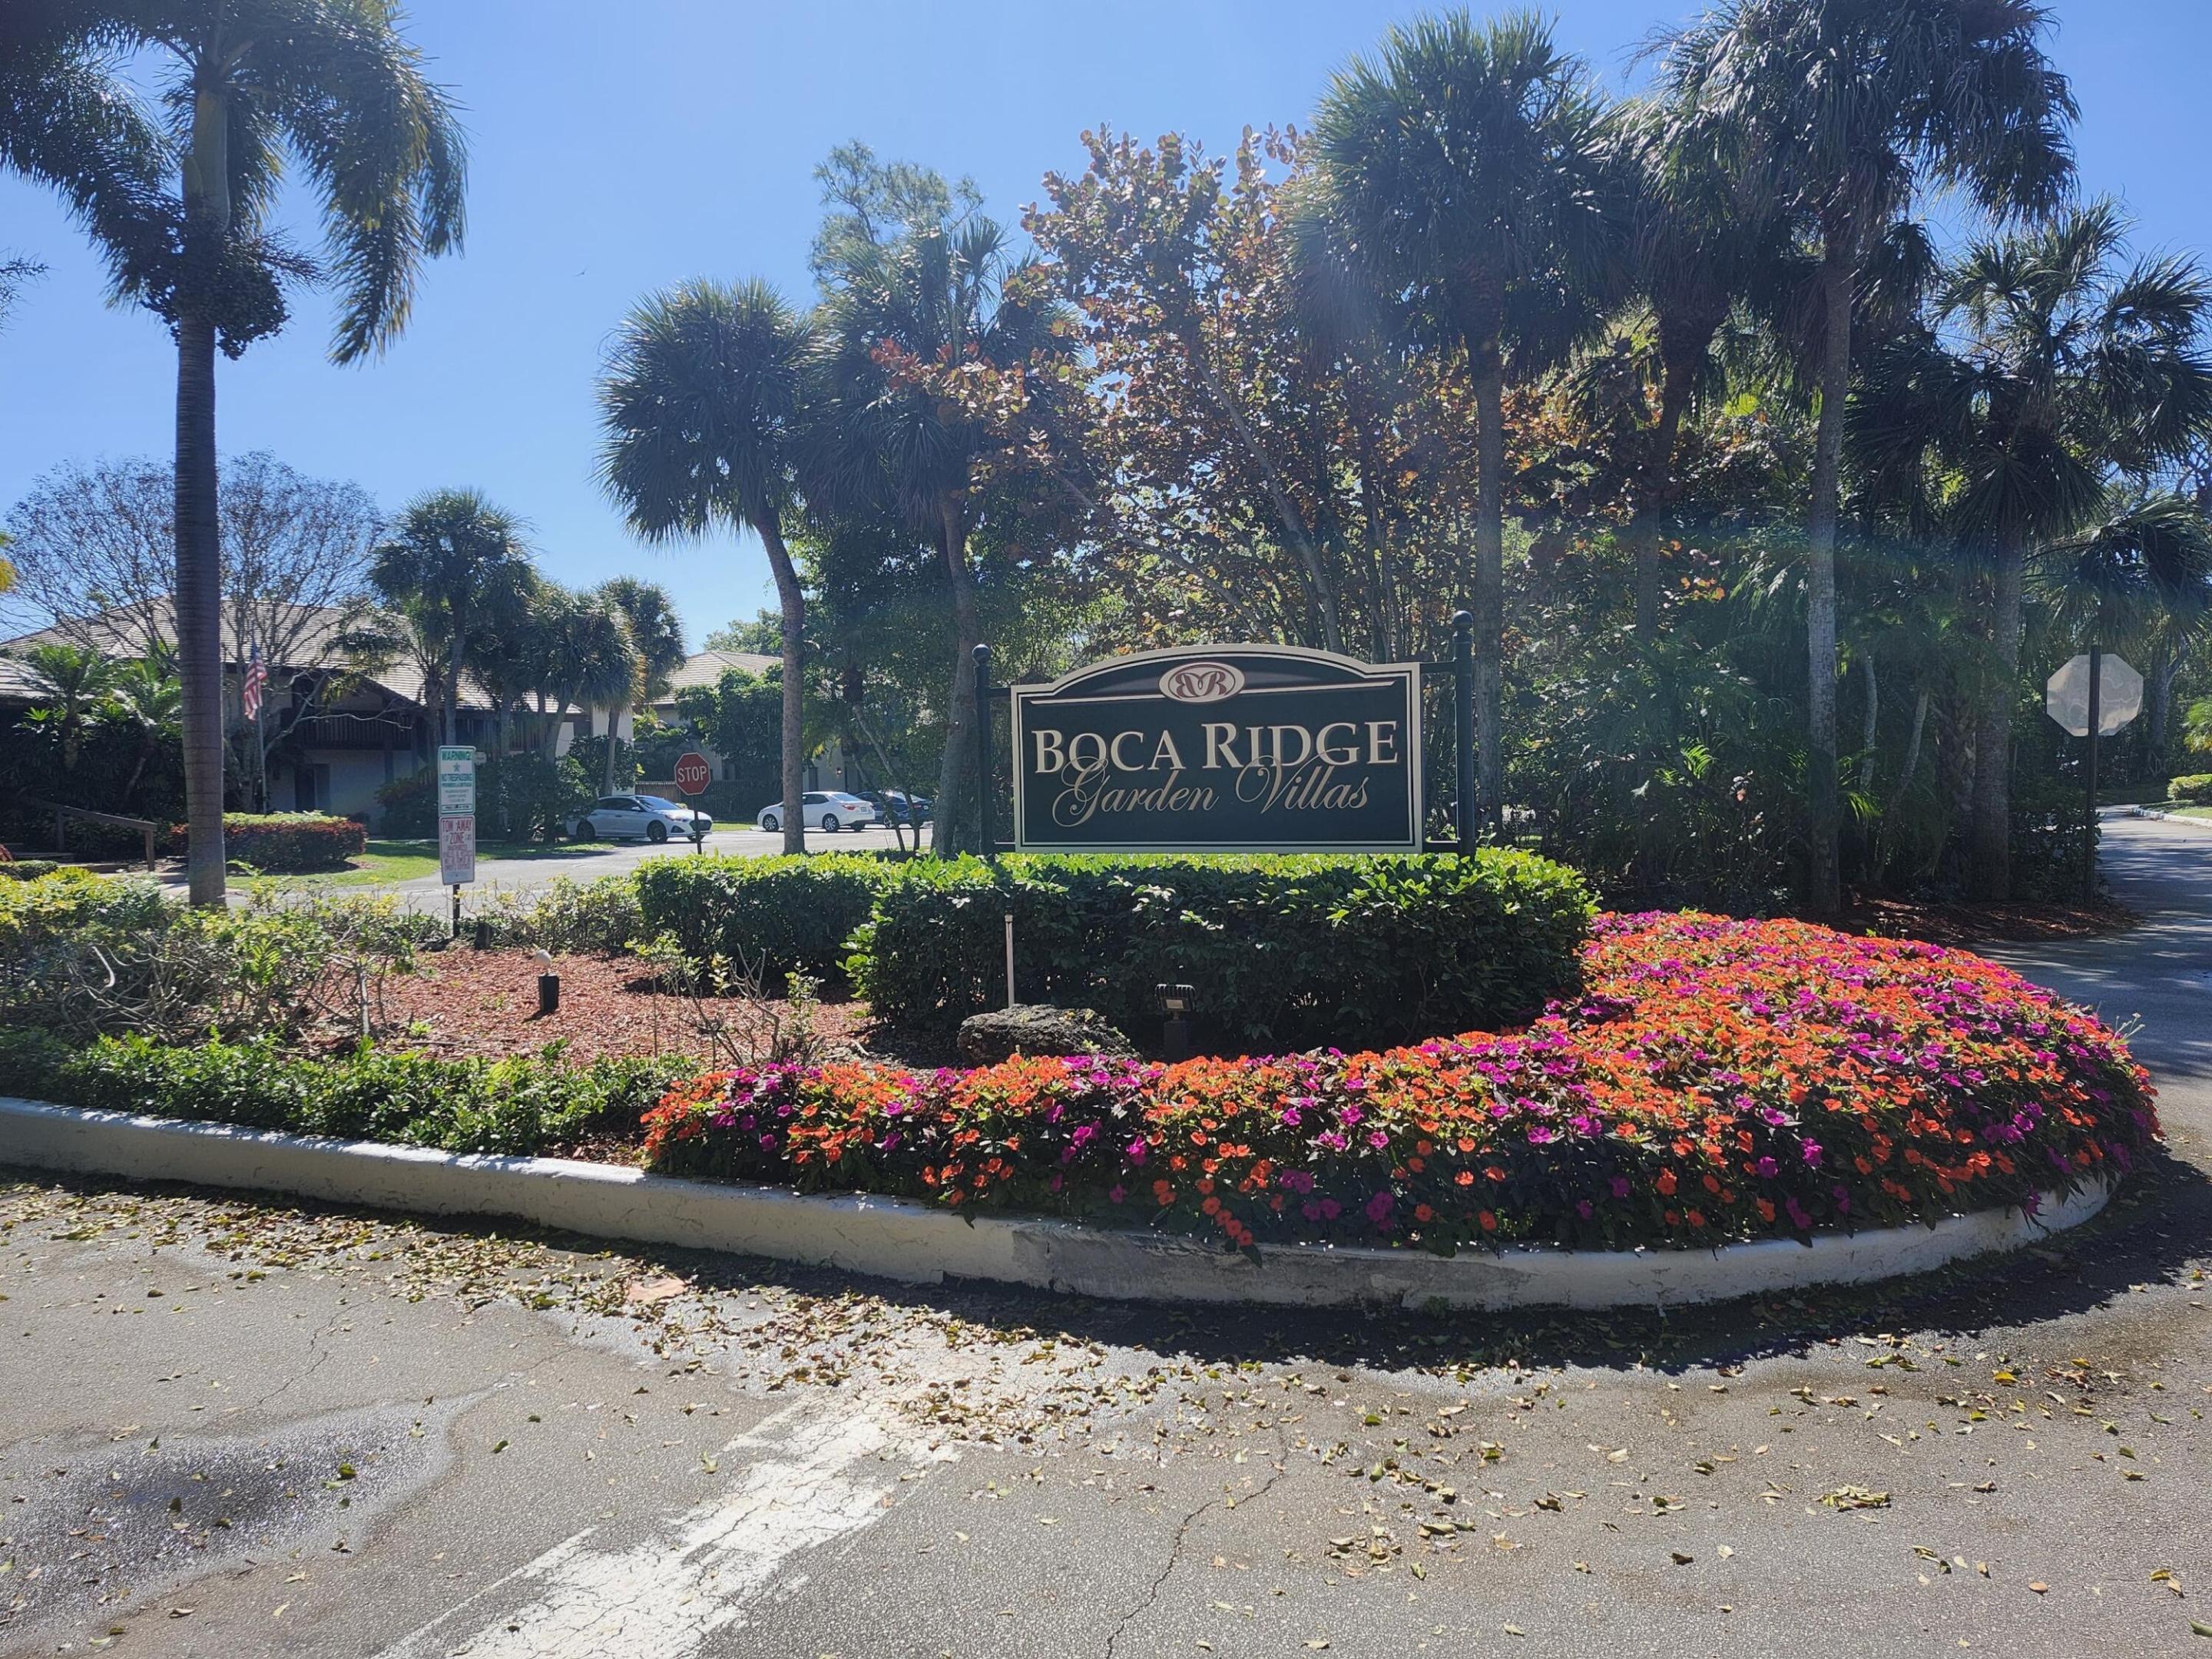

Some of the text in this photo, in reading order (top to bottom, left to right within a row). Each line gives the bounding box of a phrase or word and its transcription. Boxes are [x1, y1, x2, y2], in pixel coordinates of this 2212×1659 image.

[1031, 720, 1399, 773] BOCA RIDGE
[677, 766, 707, 783] STOP
[1052, 747, 1369, 827] Garden Villas
[449, 832, 465, 844] ZONE
